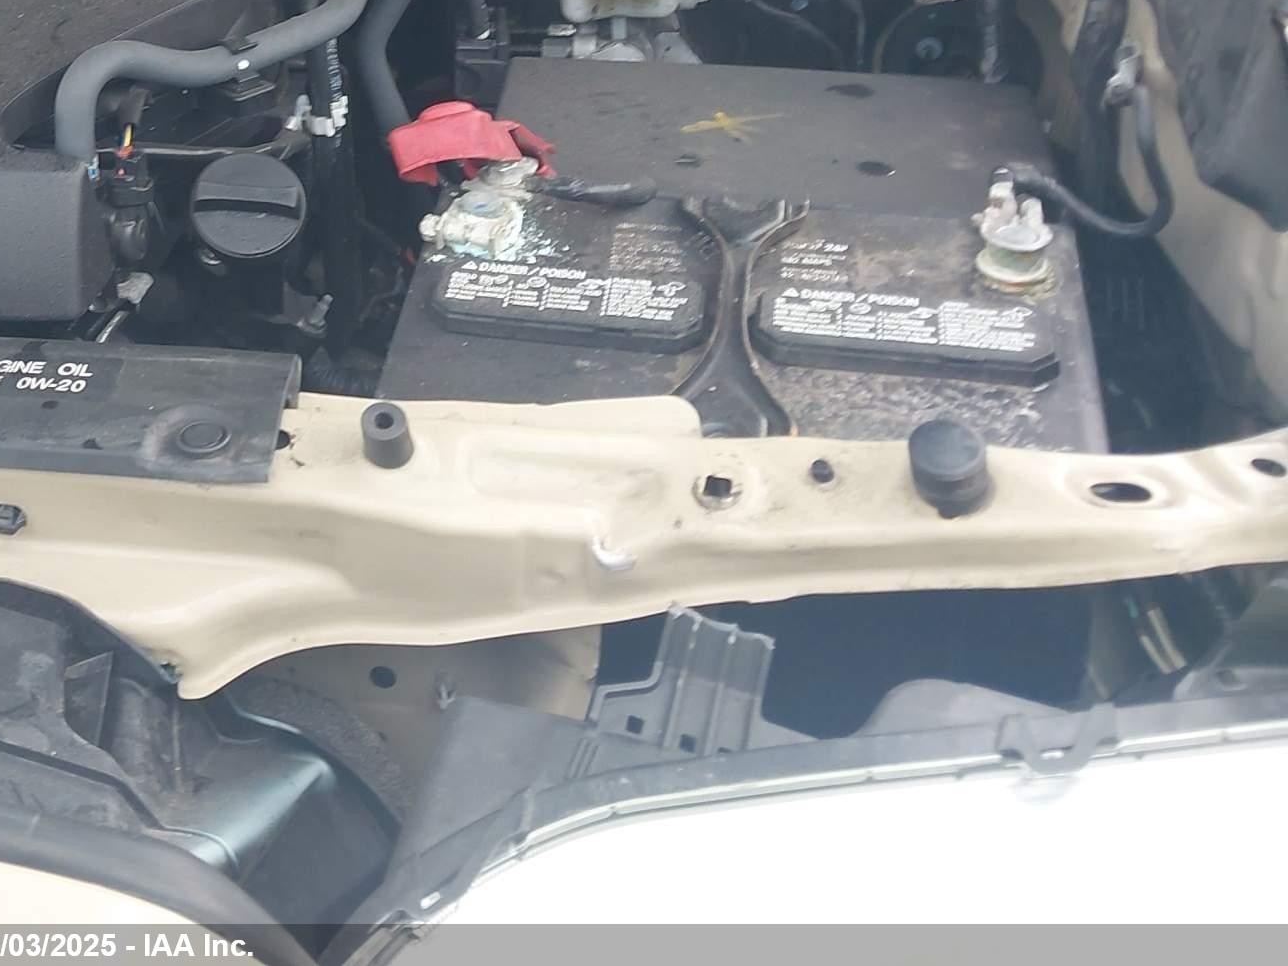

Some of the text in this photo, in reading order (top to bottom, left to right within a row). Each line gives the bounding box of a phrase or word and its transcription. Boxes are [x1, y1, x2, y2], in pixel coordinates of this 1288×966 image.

[478, 262, 530, 276] DANGER
[539, 267, 587, 280] POISON
[800, 288, 857, 303] DANGER
[868, 293, 921, 308] POISON
[57, 362, 94, 378] OIL
[16, 377, 87, 394] 0W-20
